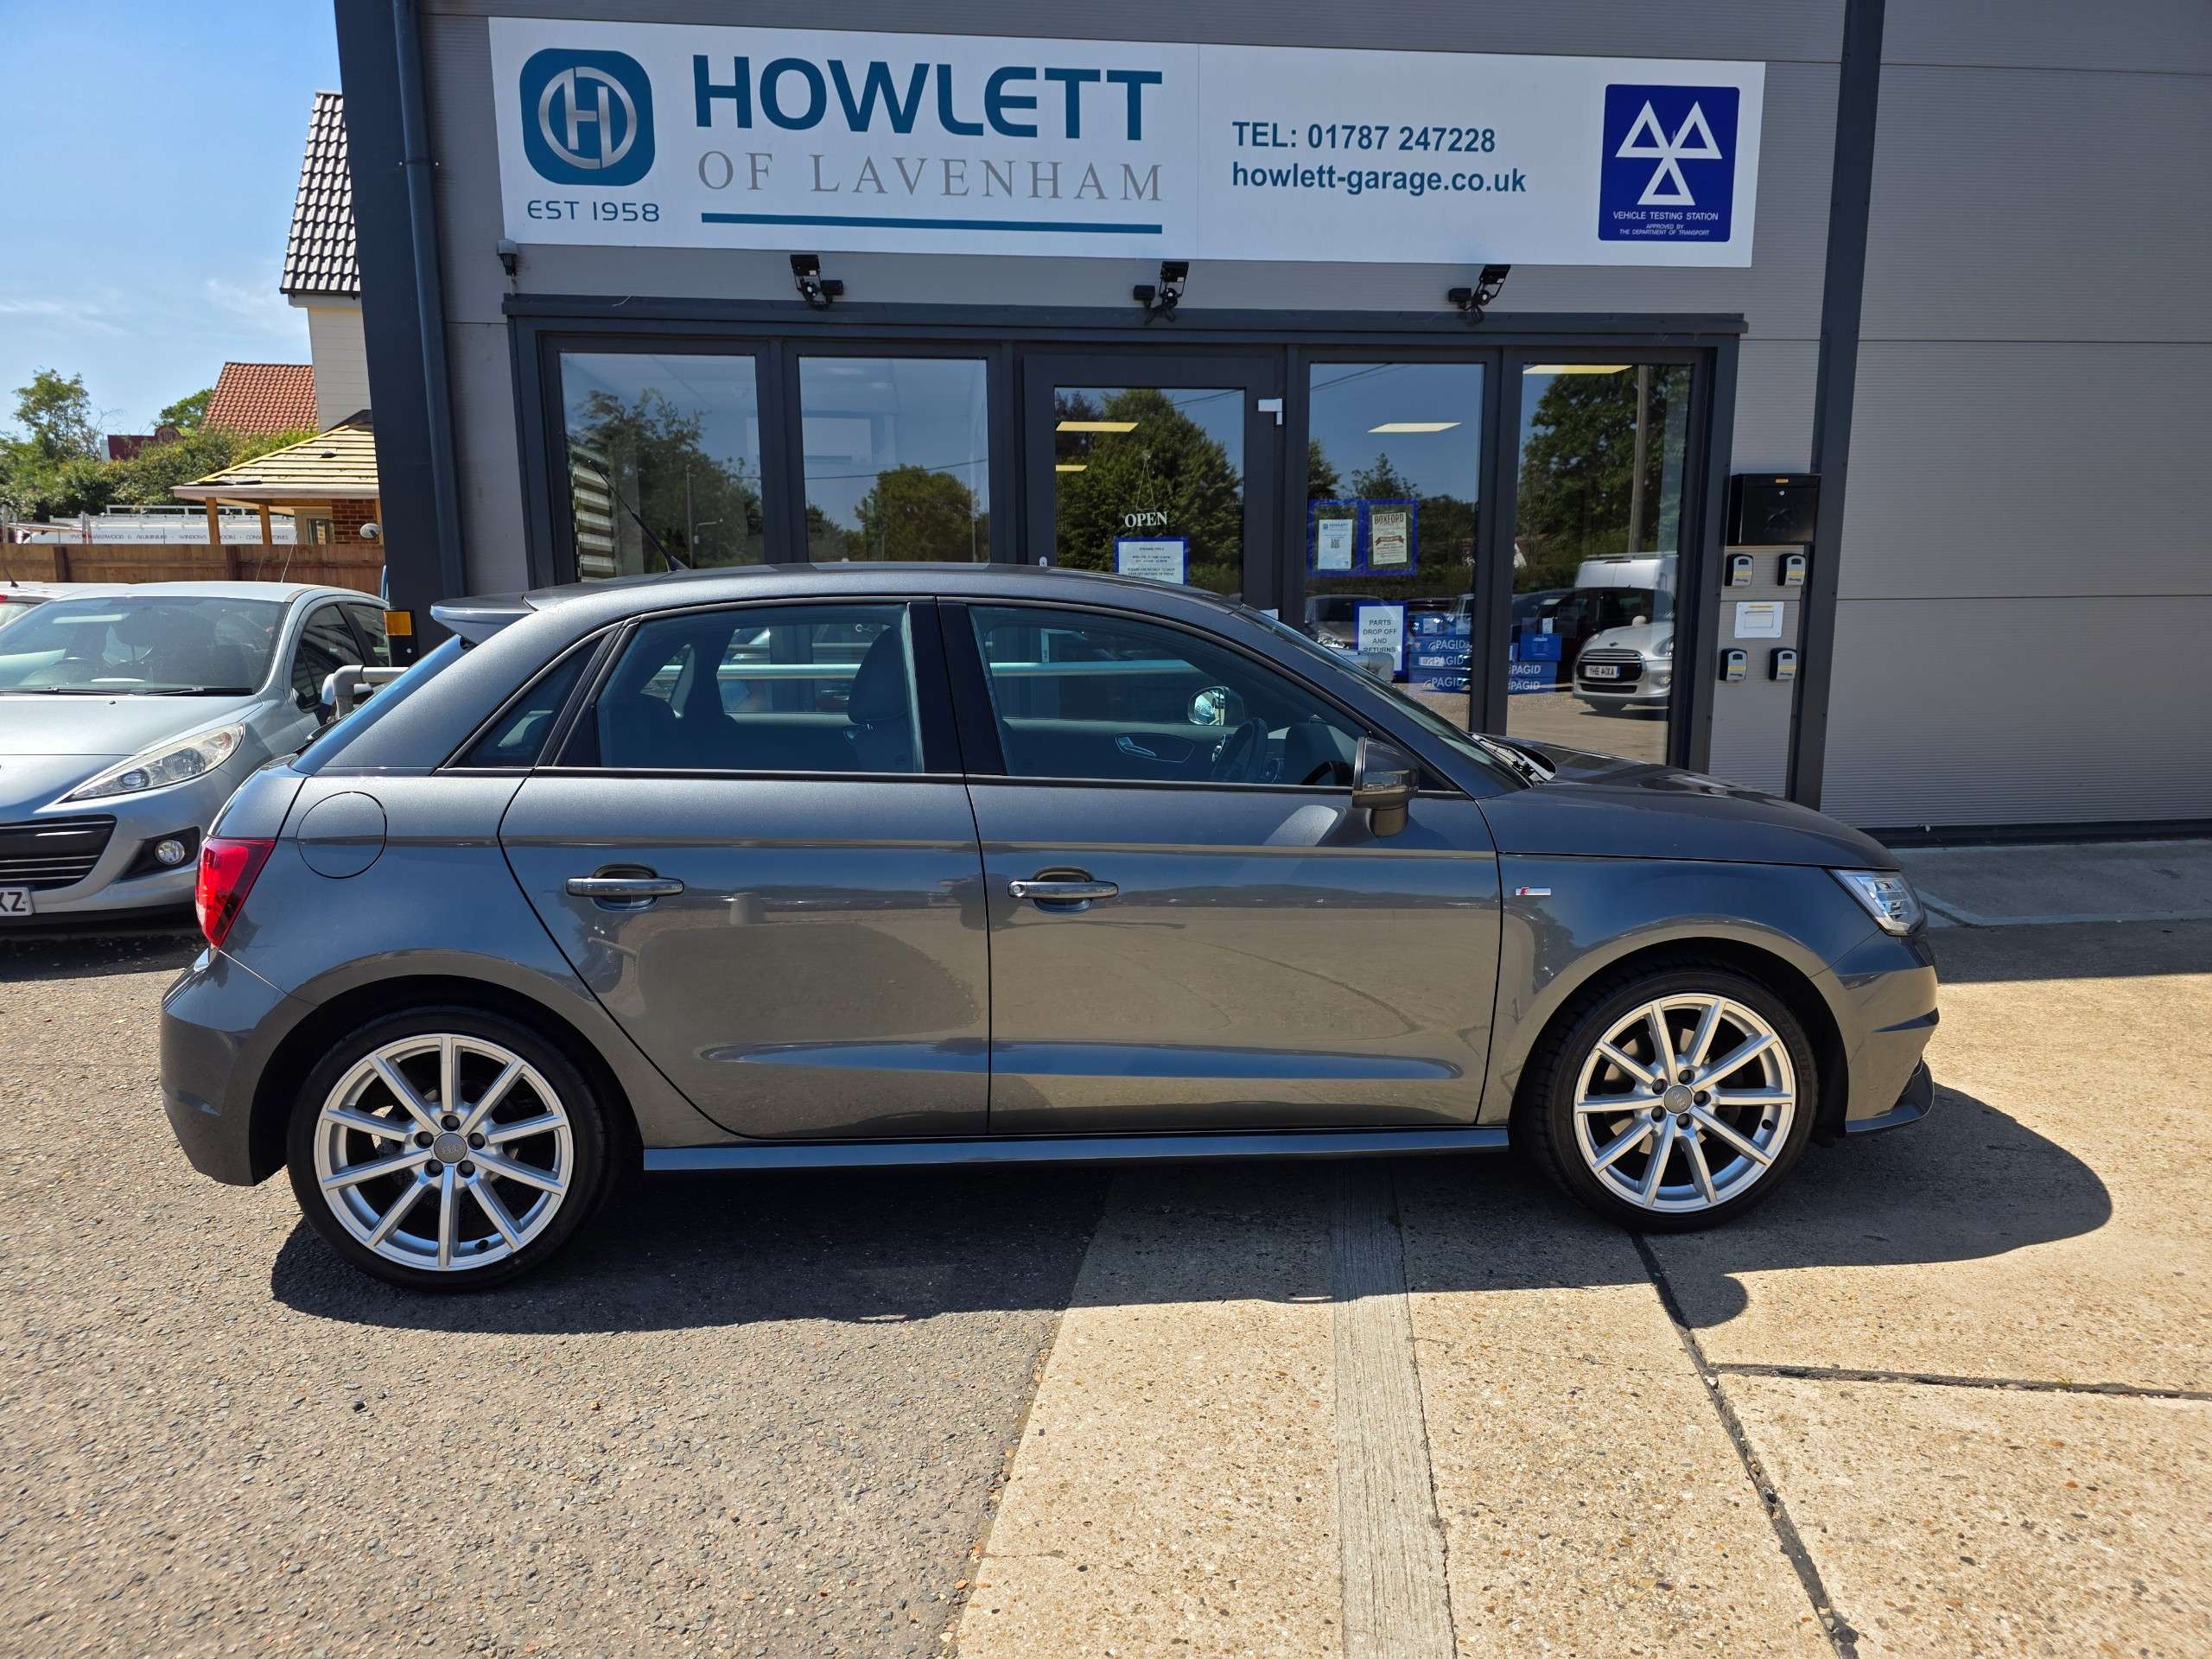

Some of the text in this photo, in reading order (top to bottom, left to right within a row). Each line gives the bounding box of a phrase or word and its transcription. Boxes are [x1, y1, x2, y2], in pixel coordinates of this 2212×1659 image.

[692, 54, 1163, 141] HOWLETT
[1231, 121, 1496, 153] TEL: 01787 247228
[698, 150, 1163, 201] OF LAVENHAM
[1232, 162, 1527, 197] howlett-garage.co.uk
[527, 200, 660, 222] EST 1958
[1613, 211, 1719, 220] VEHICLE TESTING STATION
[1124, 512, 1167, 527] OPEN
[1436, 639, 1466, 649] PAGID
[1434, 656, 1464, 665] PAGID
[1512, 664, 1541, 675] PAGID
[1431, 677, 1465, 688] PAGID
[1510, 680, 1541, 690] PAGID
